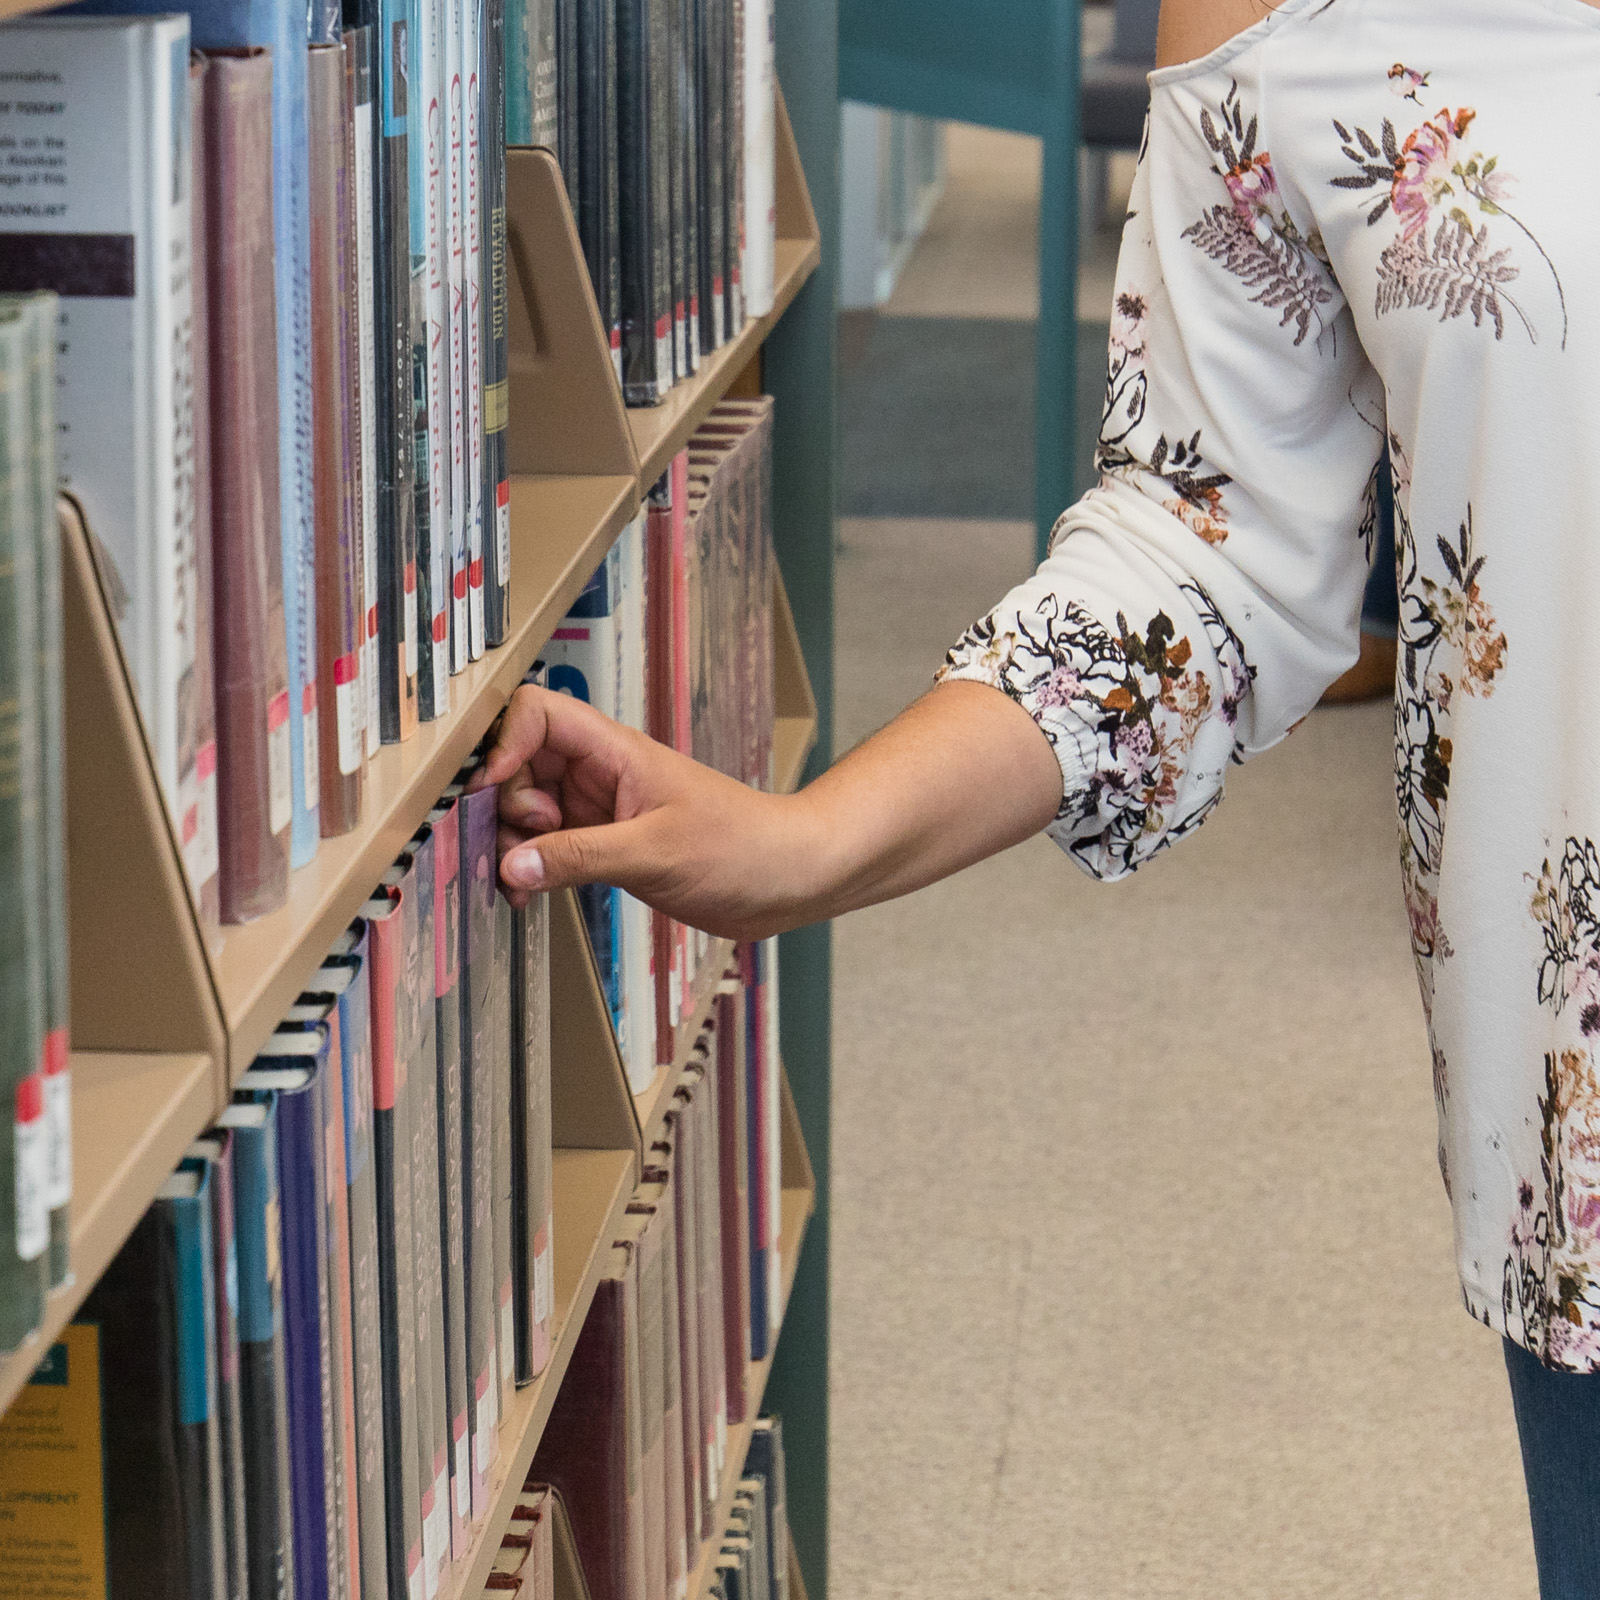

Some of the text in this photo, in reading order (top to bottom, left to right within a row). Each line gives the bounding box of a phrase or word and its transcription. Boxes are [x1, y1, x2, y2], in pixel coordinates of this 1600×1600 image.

[427, 97, 441, 291] Colonial
[450, 73, 462, 258] Colonial
[468, 72, 479, 255] Colonial
[492, 206, 503, 341] REVOLUTION
[294, 371, 305, 504] Indian
[430, 318, 442, 508] America
[453, 283, 463, 466] America
[470, 280, 480, 461] America
[527, 923, 538, 1111] DECADES
[448, 1064, 458, 1267] DECADES
[474, 1031, 484, 1230] DECADES
[413, 1132, 426, 1342] DECADES
[359, 1255, 376, 1483] DECADES
